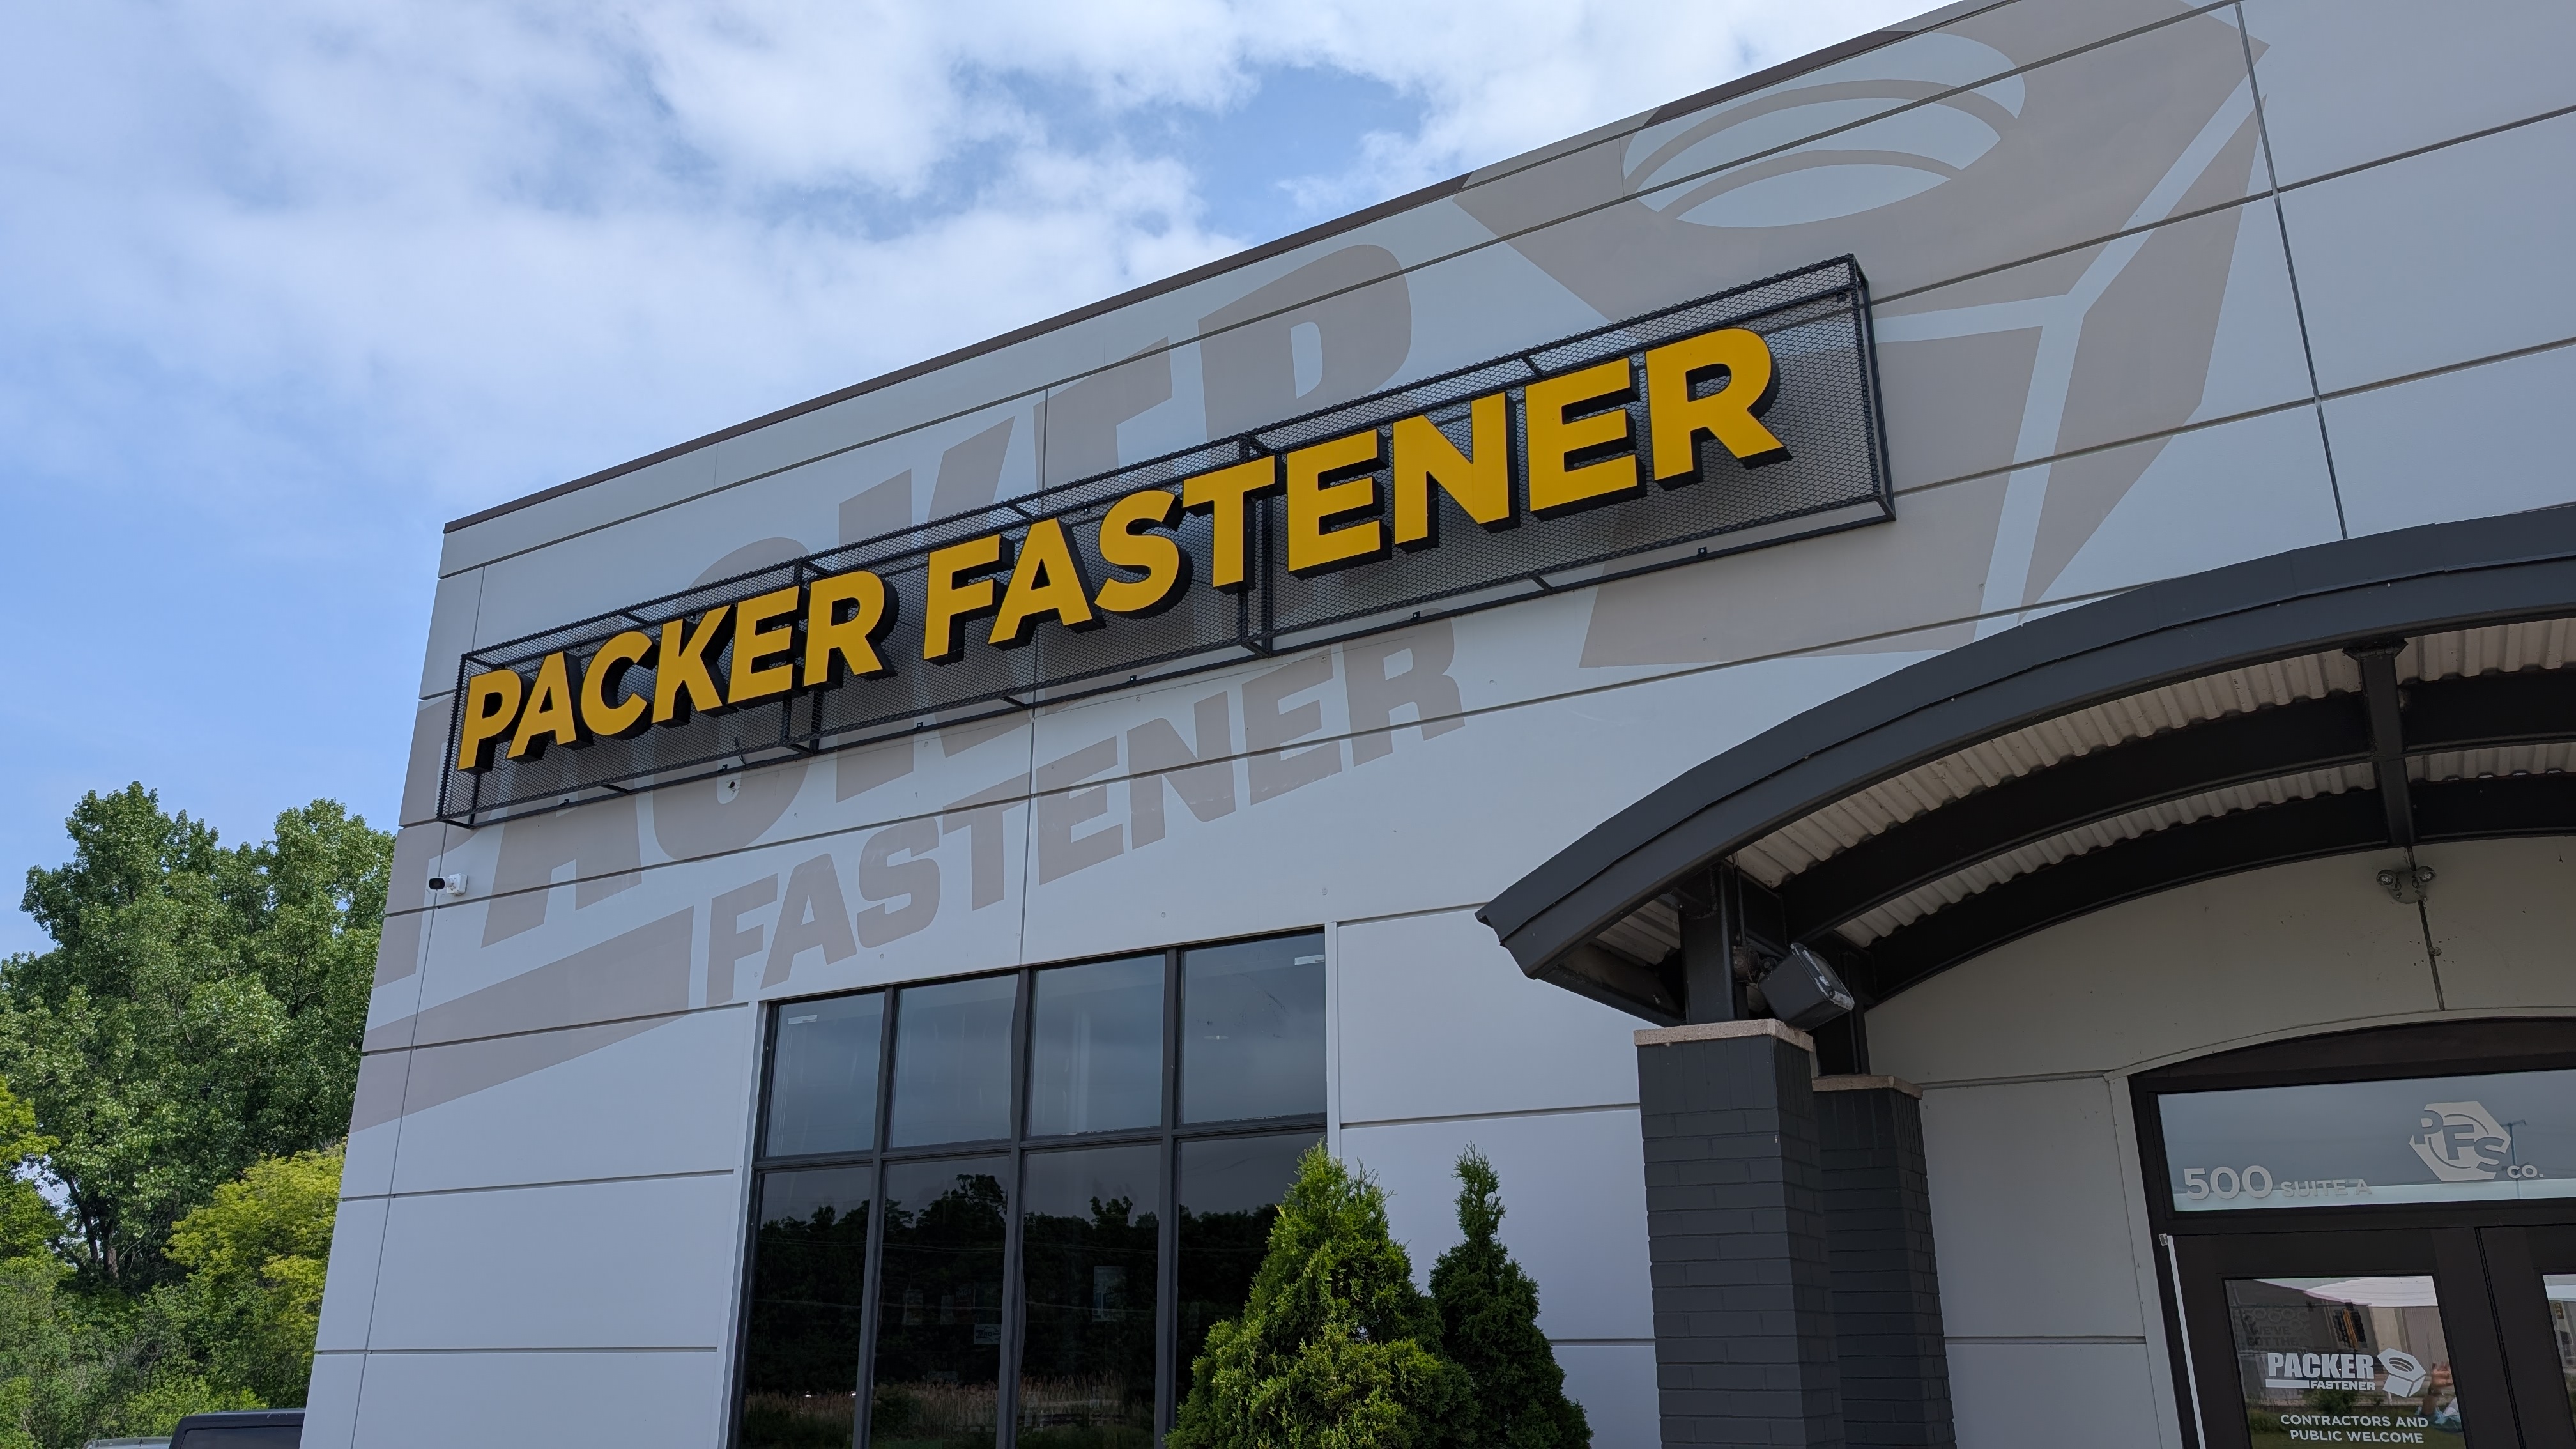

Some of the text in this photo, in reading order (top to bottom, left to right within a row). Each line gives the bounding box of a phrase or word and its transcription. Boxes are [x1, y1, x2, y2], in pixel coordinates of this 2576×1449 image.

[457, 326, 1788, 772] PACKER FASTENER
[706, 608, 1465, 1008] FASTENER
[2412, 1109, 2506, 1173] PFS
[2184, 1165, 2372, 1200] 500 SUITE A
[2507, 1164, 2544, 1179] CO.
[2267, 1353, 2375, 1379] PACKER
[2310, 1379, 2376, 1391] FASTENER
[2280, 1414, 2428, 1428] CONTRACTORS AND
[2290, 1429, 2425, 1444] PUBLIC WELCOME
